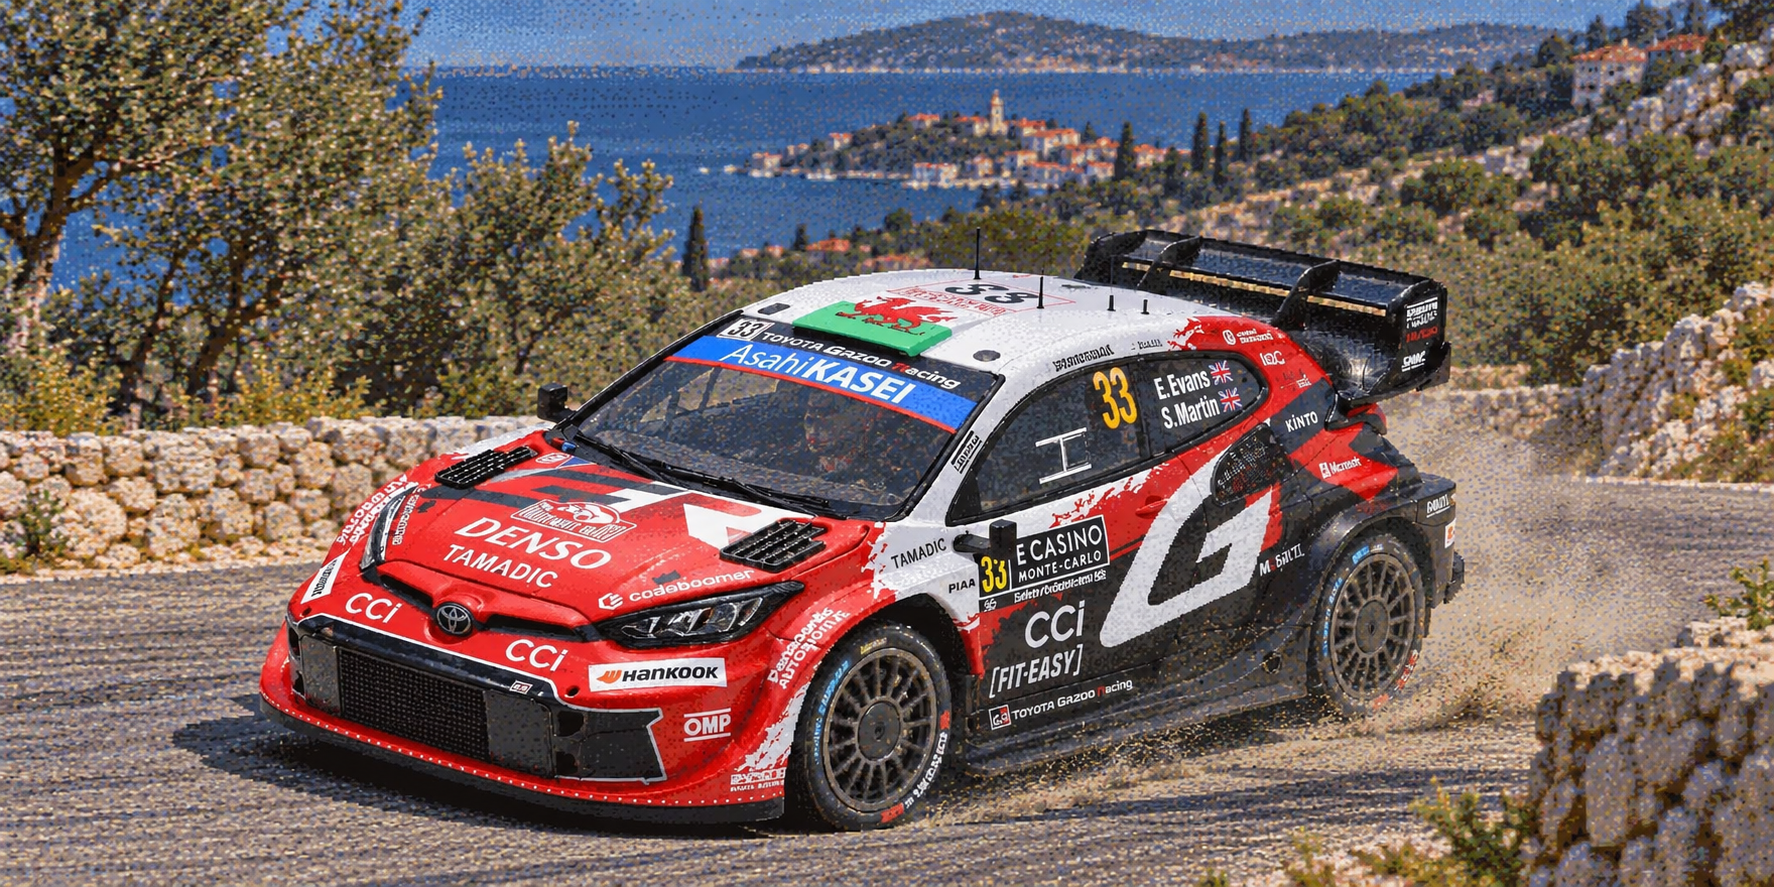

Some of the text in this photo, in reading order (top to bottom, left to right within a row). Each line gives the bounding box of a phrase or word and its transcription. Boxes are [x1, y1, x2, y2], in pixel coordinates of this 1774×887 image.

[727, 321, 764, 338] 33
[762, 332, 824, 351] TOYOTA
[1092, 366, 1137, 429] 33
[454, 517, 612, 569] DENSO
[891, 538, 947, 568] TAMADIC
[1030, 525, 1103, 560] CASINO
[443, 544, 558, 588] TAMADIC
[1018, 550, 1102, 582] MONTE-CARLO
[629, 570, 754, 601] codeboomer
[948, 578, 976, 593] PIAA
[684, 714, 731, 736] OMP
[1011, 701, 1055, 719] TOYOTA
